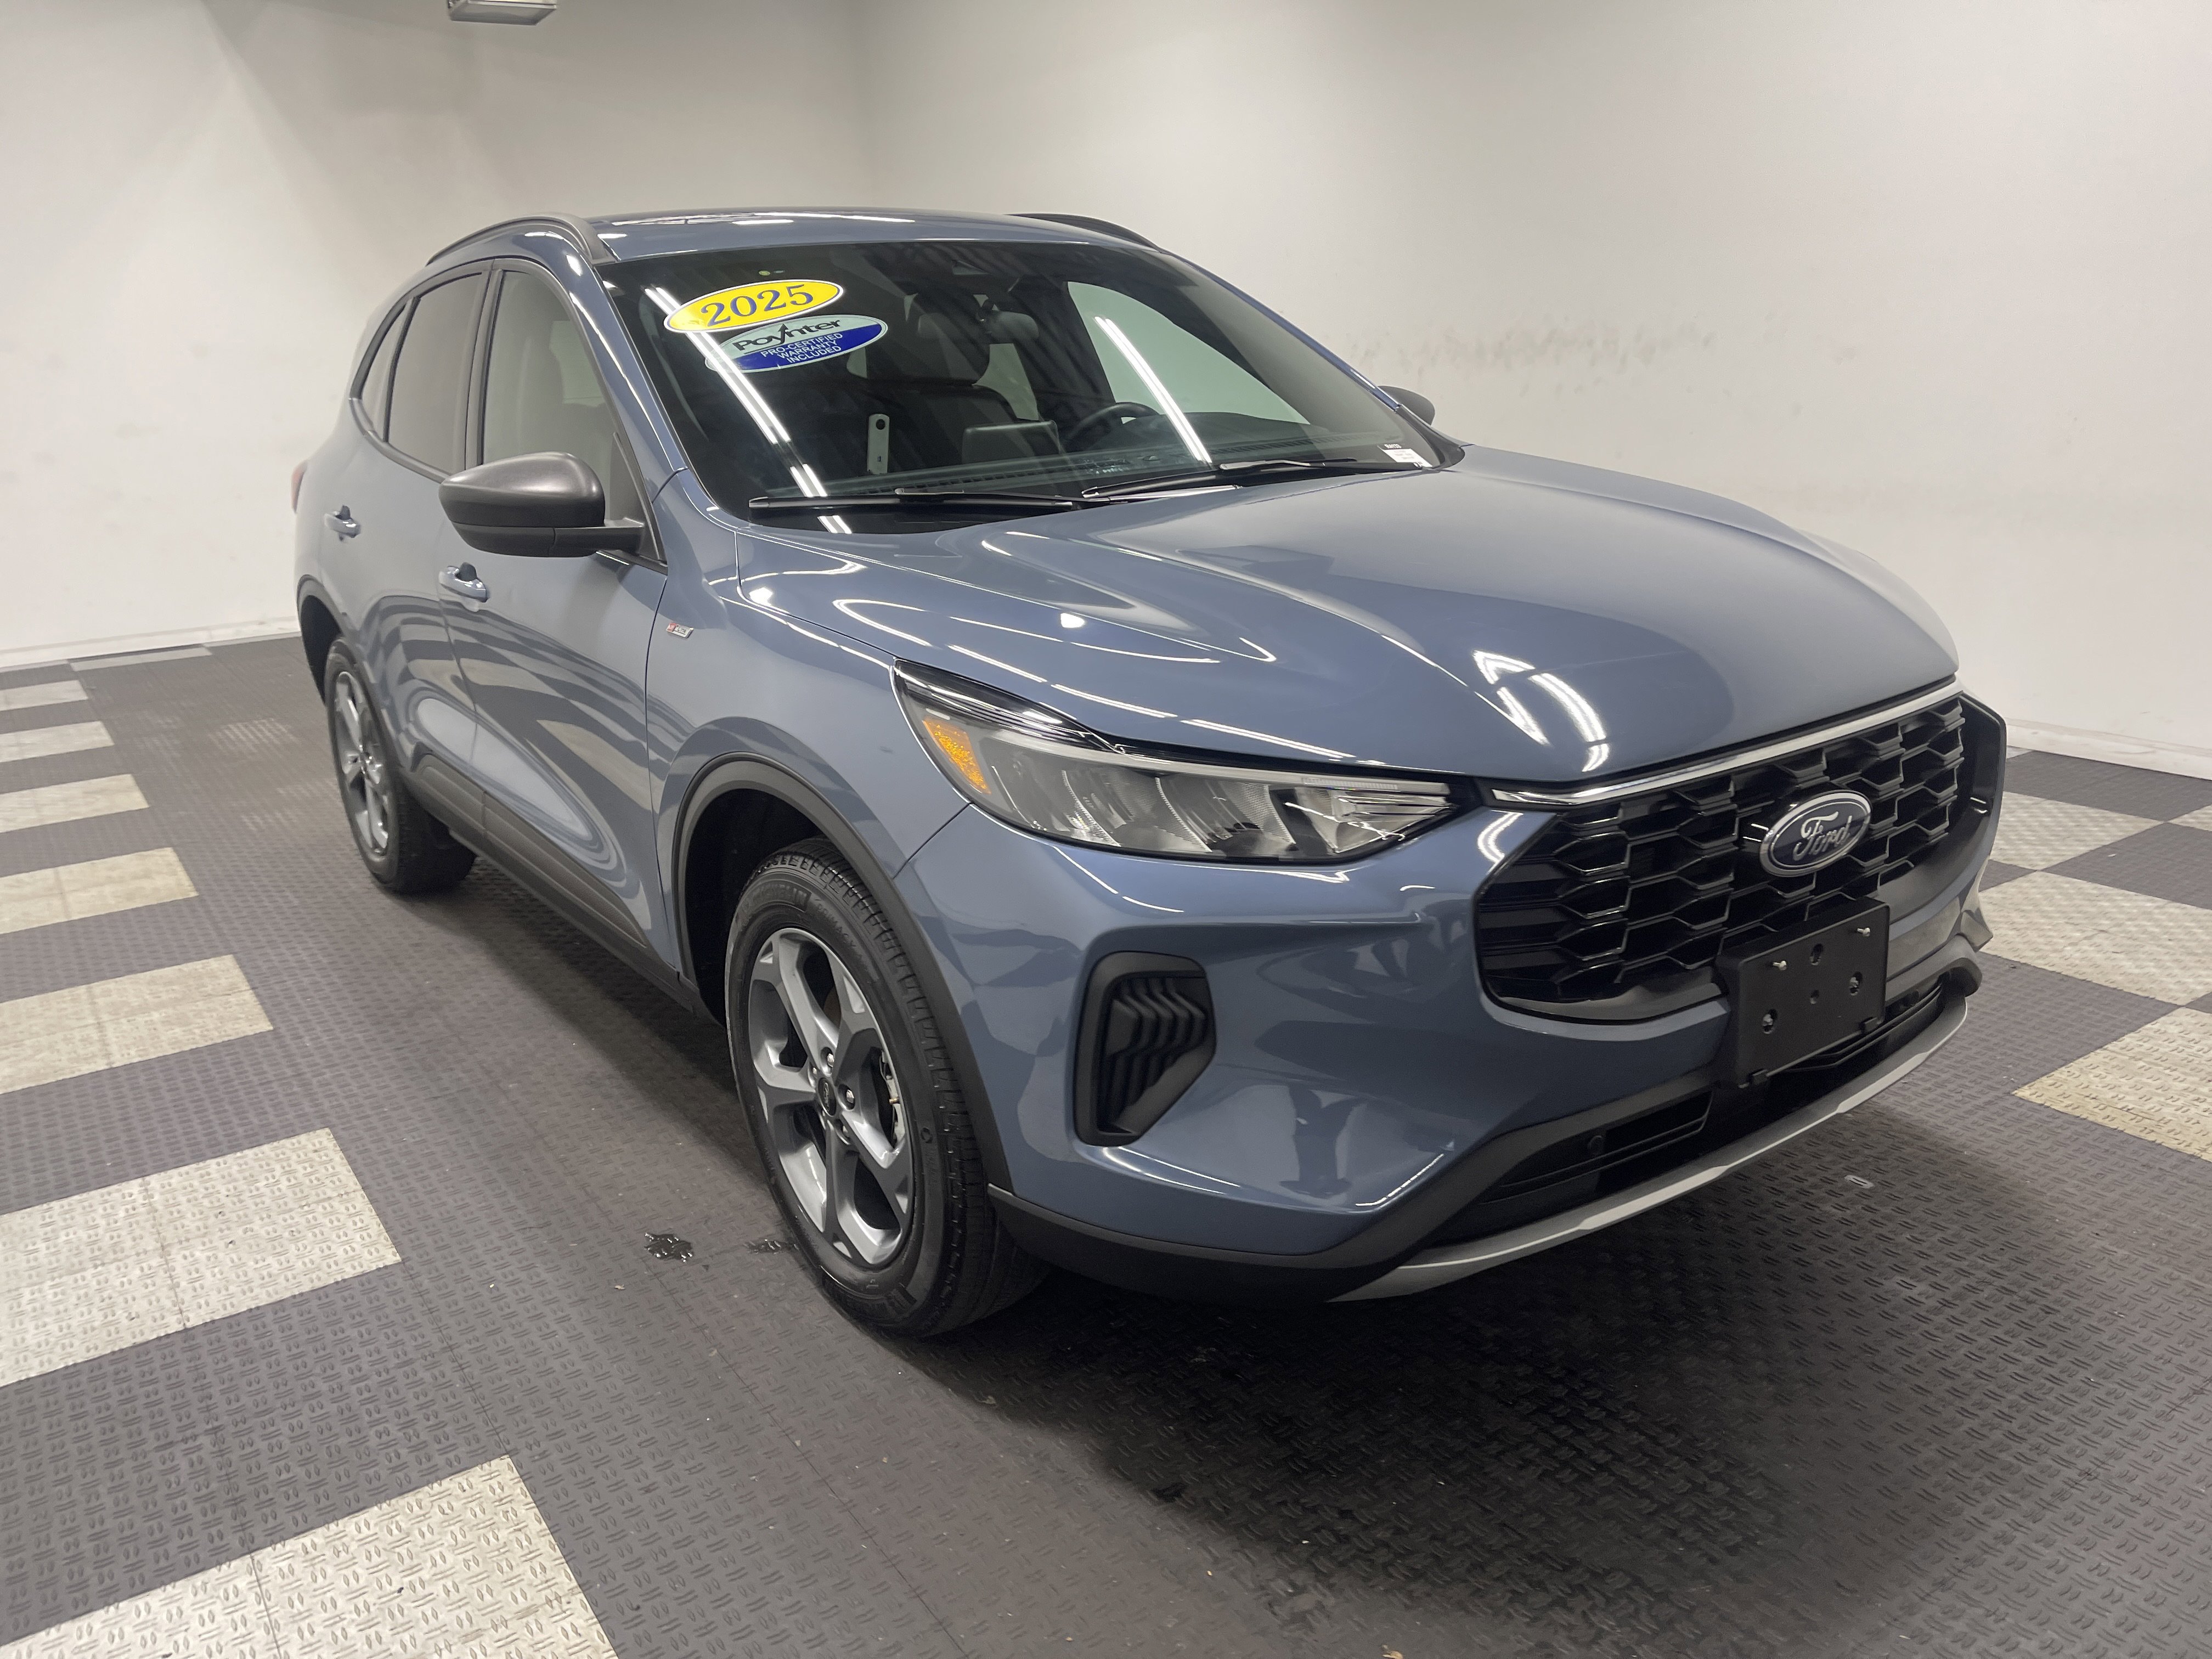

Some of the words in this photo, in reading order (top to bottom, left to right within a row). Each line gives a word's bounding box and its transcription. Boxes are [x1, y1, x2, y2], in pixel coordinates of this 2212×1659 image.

[701, 284, 814, 326] 2025
[732, 319, 841, 353] Poynter
[760, 333, 843, 357] PRO-CERTIFIED
[777, 340, 837, 359] WARRANTY
[786, 346, 842, 363] INCLUDED
[1793, 811, 1852, 861] Ford
